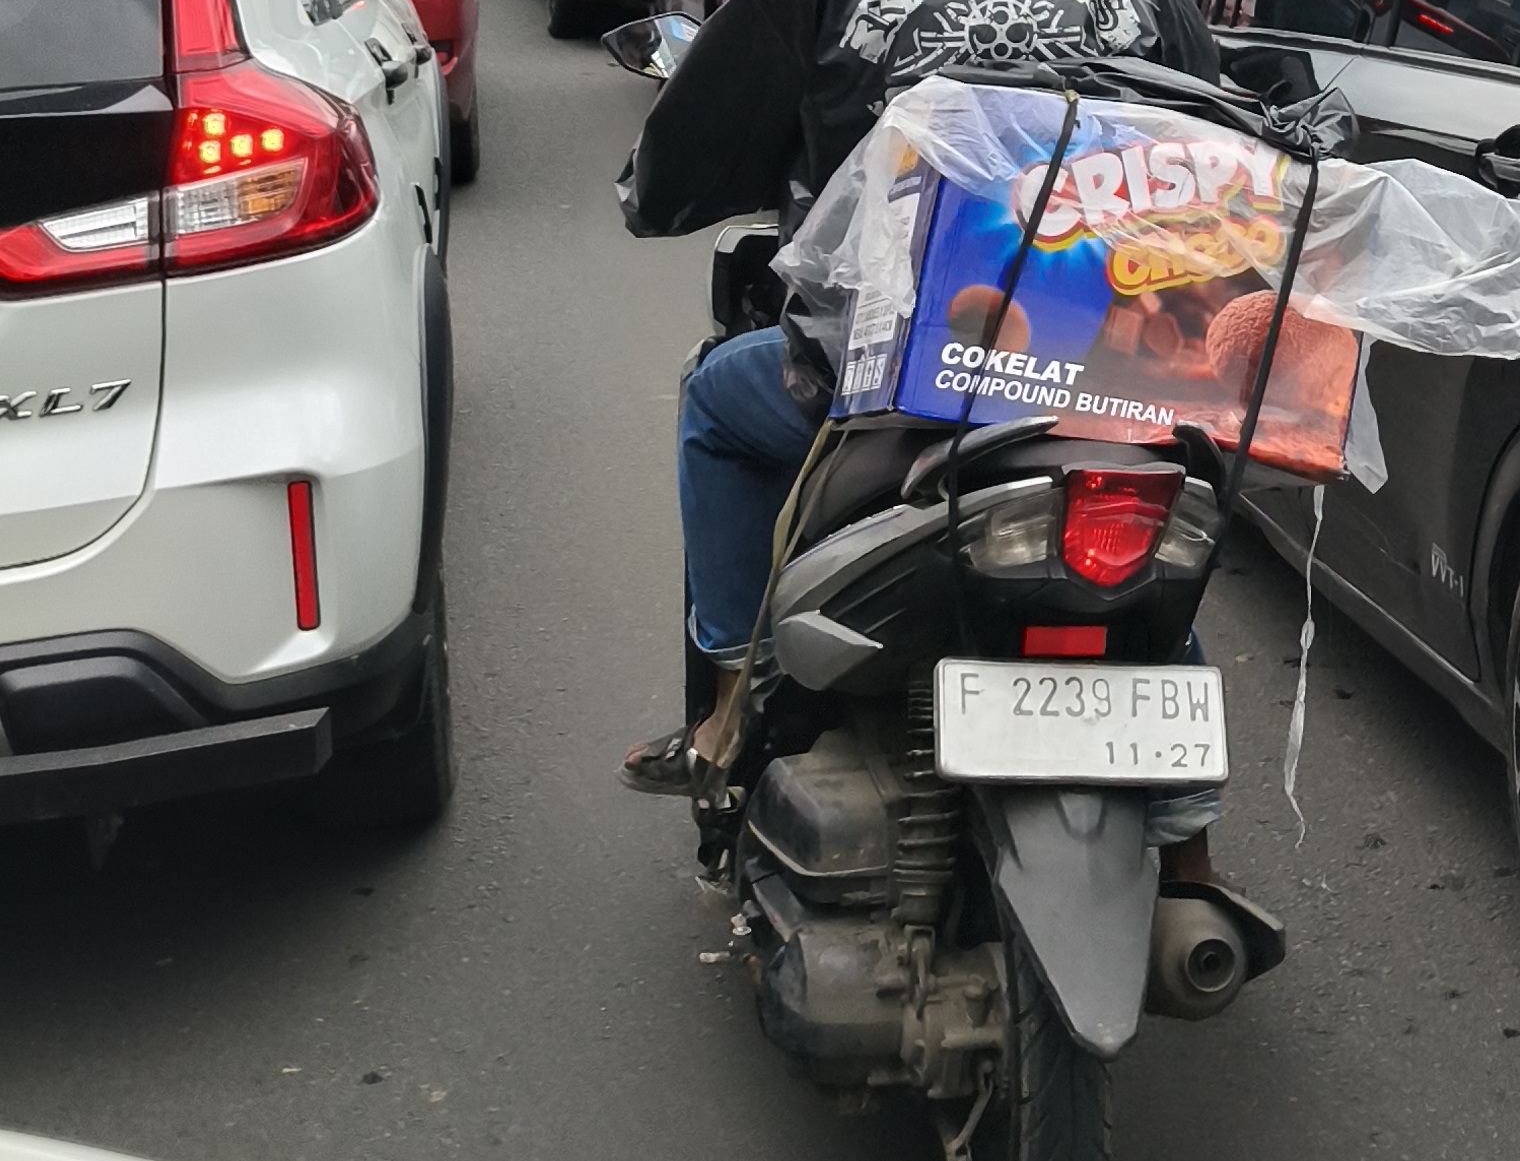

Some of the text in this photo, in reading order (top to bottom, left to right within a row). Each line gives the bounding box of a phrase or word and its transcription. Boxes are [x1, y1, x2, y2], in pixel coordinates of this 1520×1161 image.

[1016, 141, 1280, 238] CRISPY
[940, 342, 1085, 385] COKELAT
[0, 378, 132, 420] XL7
[934, 369, 1174, 425] COMPOUND BUTIRAN
[960, 673, 1209, 723] F 2239 FBW
